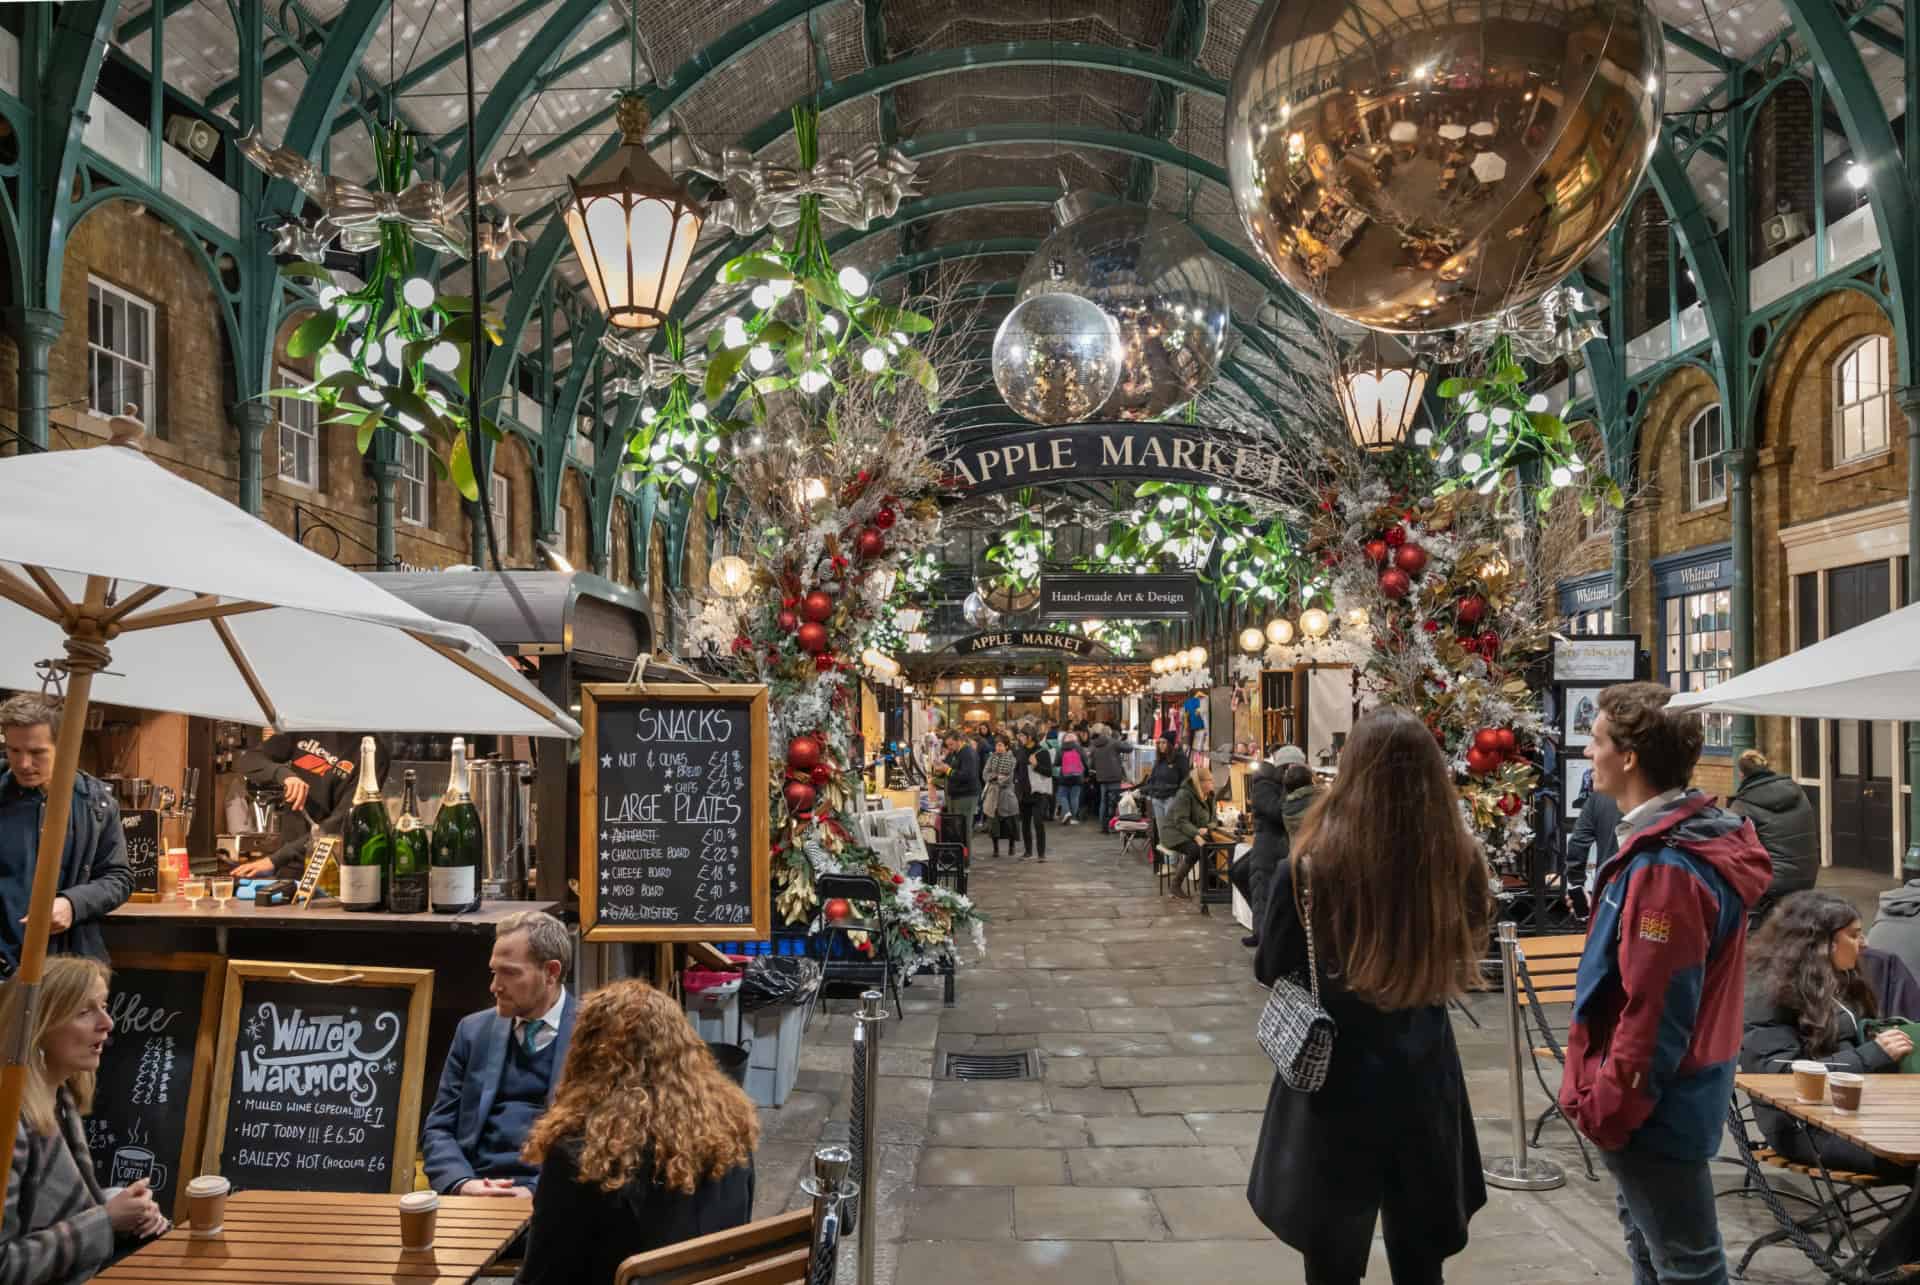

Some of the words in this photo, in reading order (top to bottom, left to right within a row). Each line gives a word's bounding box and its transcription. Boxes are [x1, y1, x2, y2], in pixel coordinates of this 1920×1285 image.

[951, 437, 1077, 486] APPLE
[1679, 562, 1720, 585] Whittard
[1051, 590, 1113, 602] Hand-made
[1115, 590, 1132, 602] Art
[1135, 591, 1144, 602] &
[1147, 591, 1185, 604] Design
[971, 634, 1012, 651] APPLE
[1022, 633, 1083, 651] MARKET
[636, 708, 732, 742] SNACKS
[604, 793, 664, 822] LARGE
[673, 793, 742, 824] PLATES
[244, 1099, 282, 1112] MULLED
[286, 1103, 312, 1113] WINE
[241, 1122, 270, 1138] HOT
[273, 1123, 306, 1139] TODDY
[323, 1124, 365, 1144] £6.50
[238, 1149, 291, 1168] BAILEYS
[296, 1153, 323, 1169] HOT
